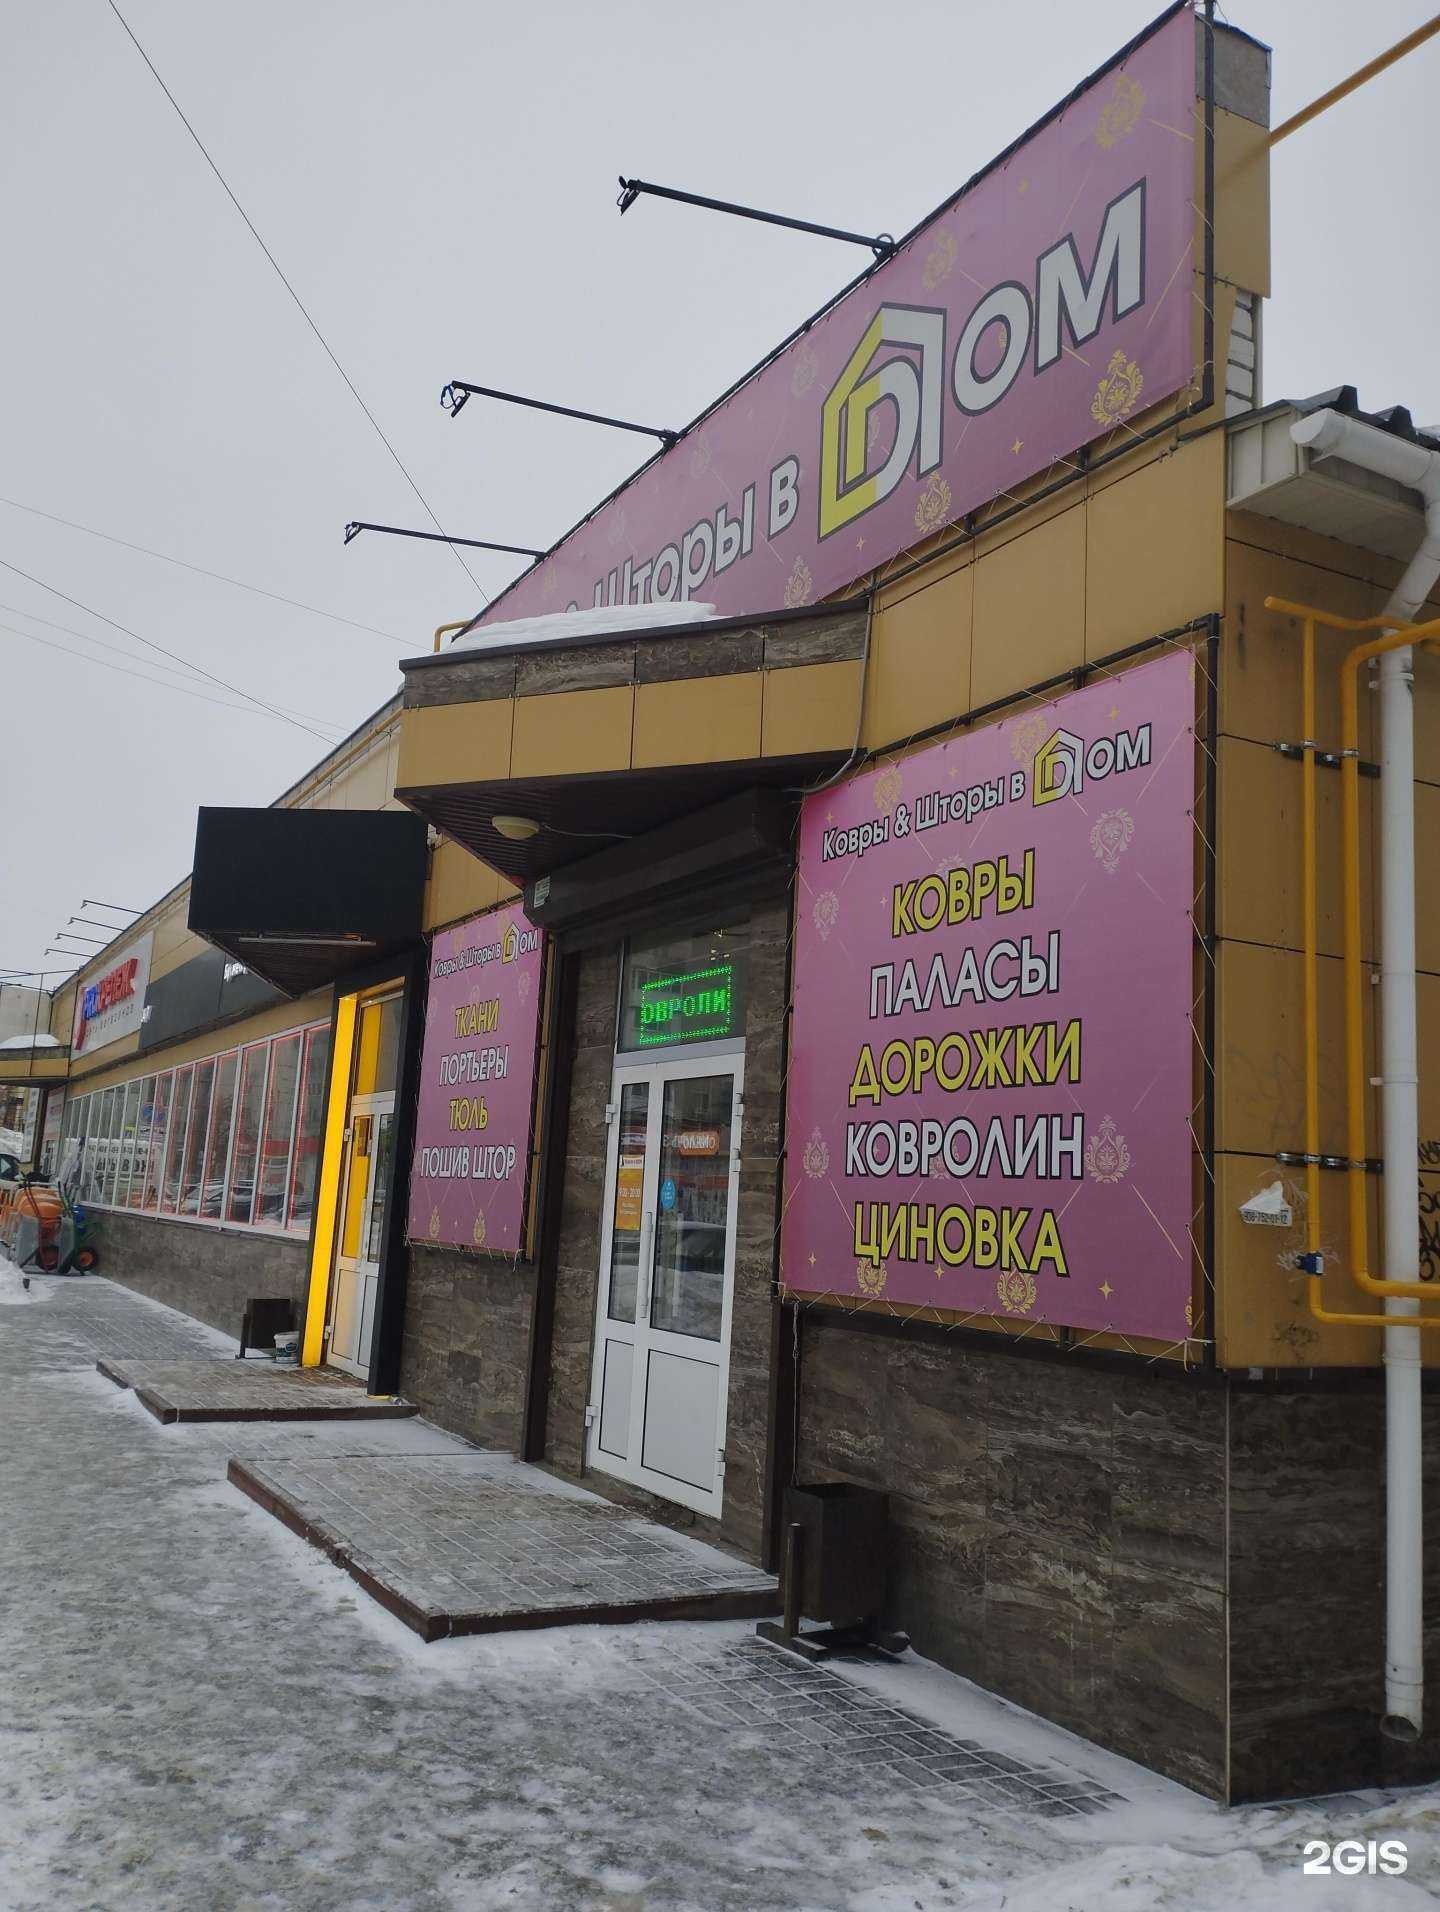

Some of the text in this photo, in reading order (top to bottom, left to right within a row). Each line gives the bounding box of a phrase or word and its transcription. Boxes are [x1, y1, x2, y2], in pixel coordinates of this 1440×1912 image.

[768, 454, 802, 542] в
[822, 817, 889, 862] Ковры
[893, 805, 912, 838] &
[915, 773, 1005, 832] Шторы
[1010, 771, 1025, 803] в
[891, 847, 1036, 939] КОВРЫ
[869, 930, 1061, 1019] ПАЛАСЫ
[454, 998, 500, 1038] ТКАНИ
[439, 1046, 509, 1086] ПОРТЬЕРЫ
[848, 1018, 1082, 1107] ДОРОЖКИ
[448, 1097, 488, 1132] ТЮЛЬ
[845, 1112, 1084, 1179] КОВРОЛИН
[420, 1145, 516, 1180] ПОШИВ ШТОР
[853, 1201, 1070, 1278] ЦИНОВКА
